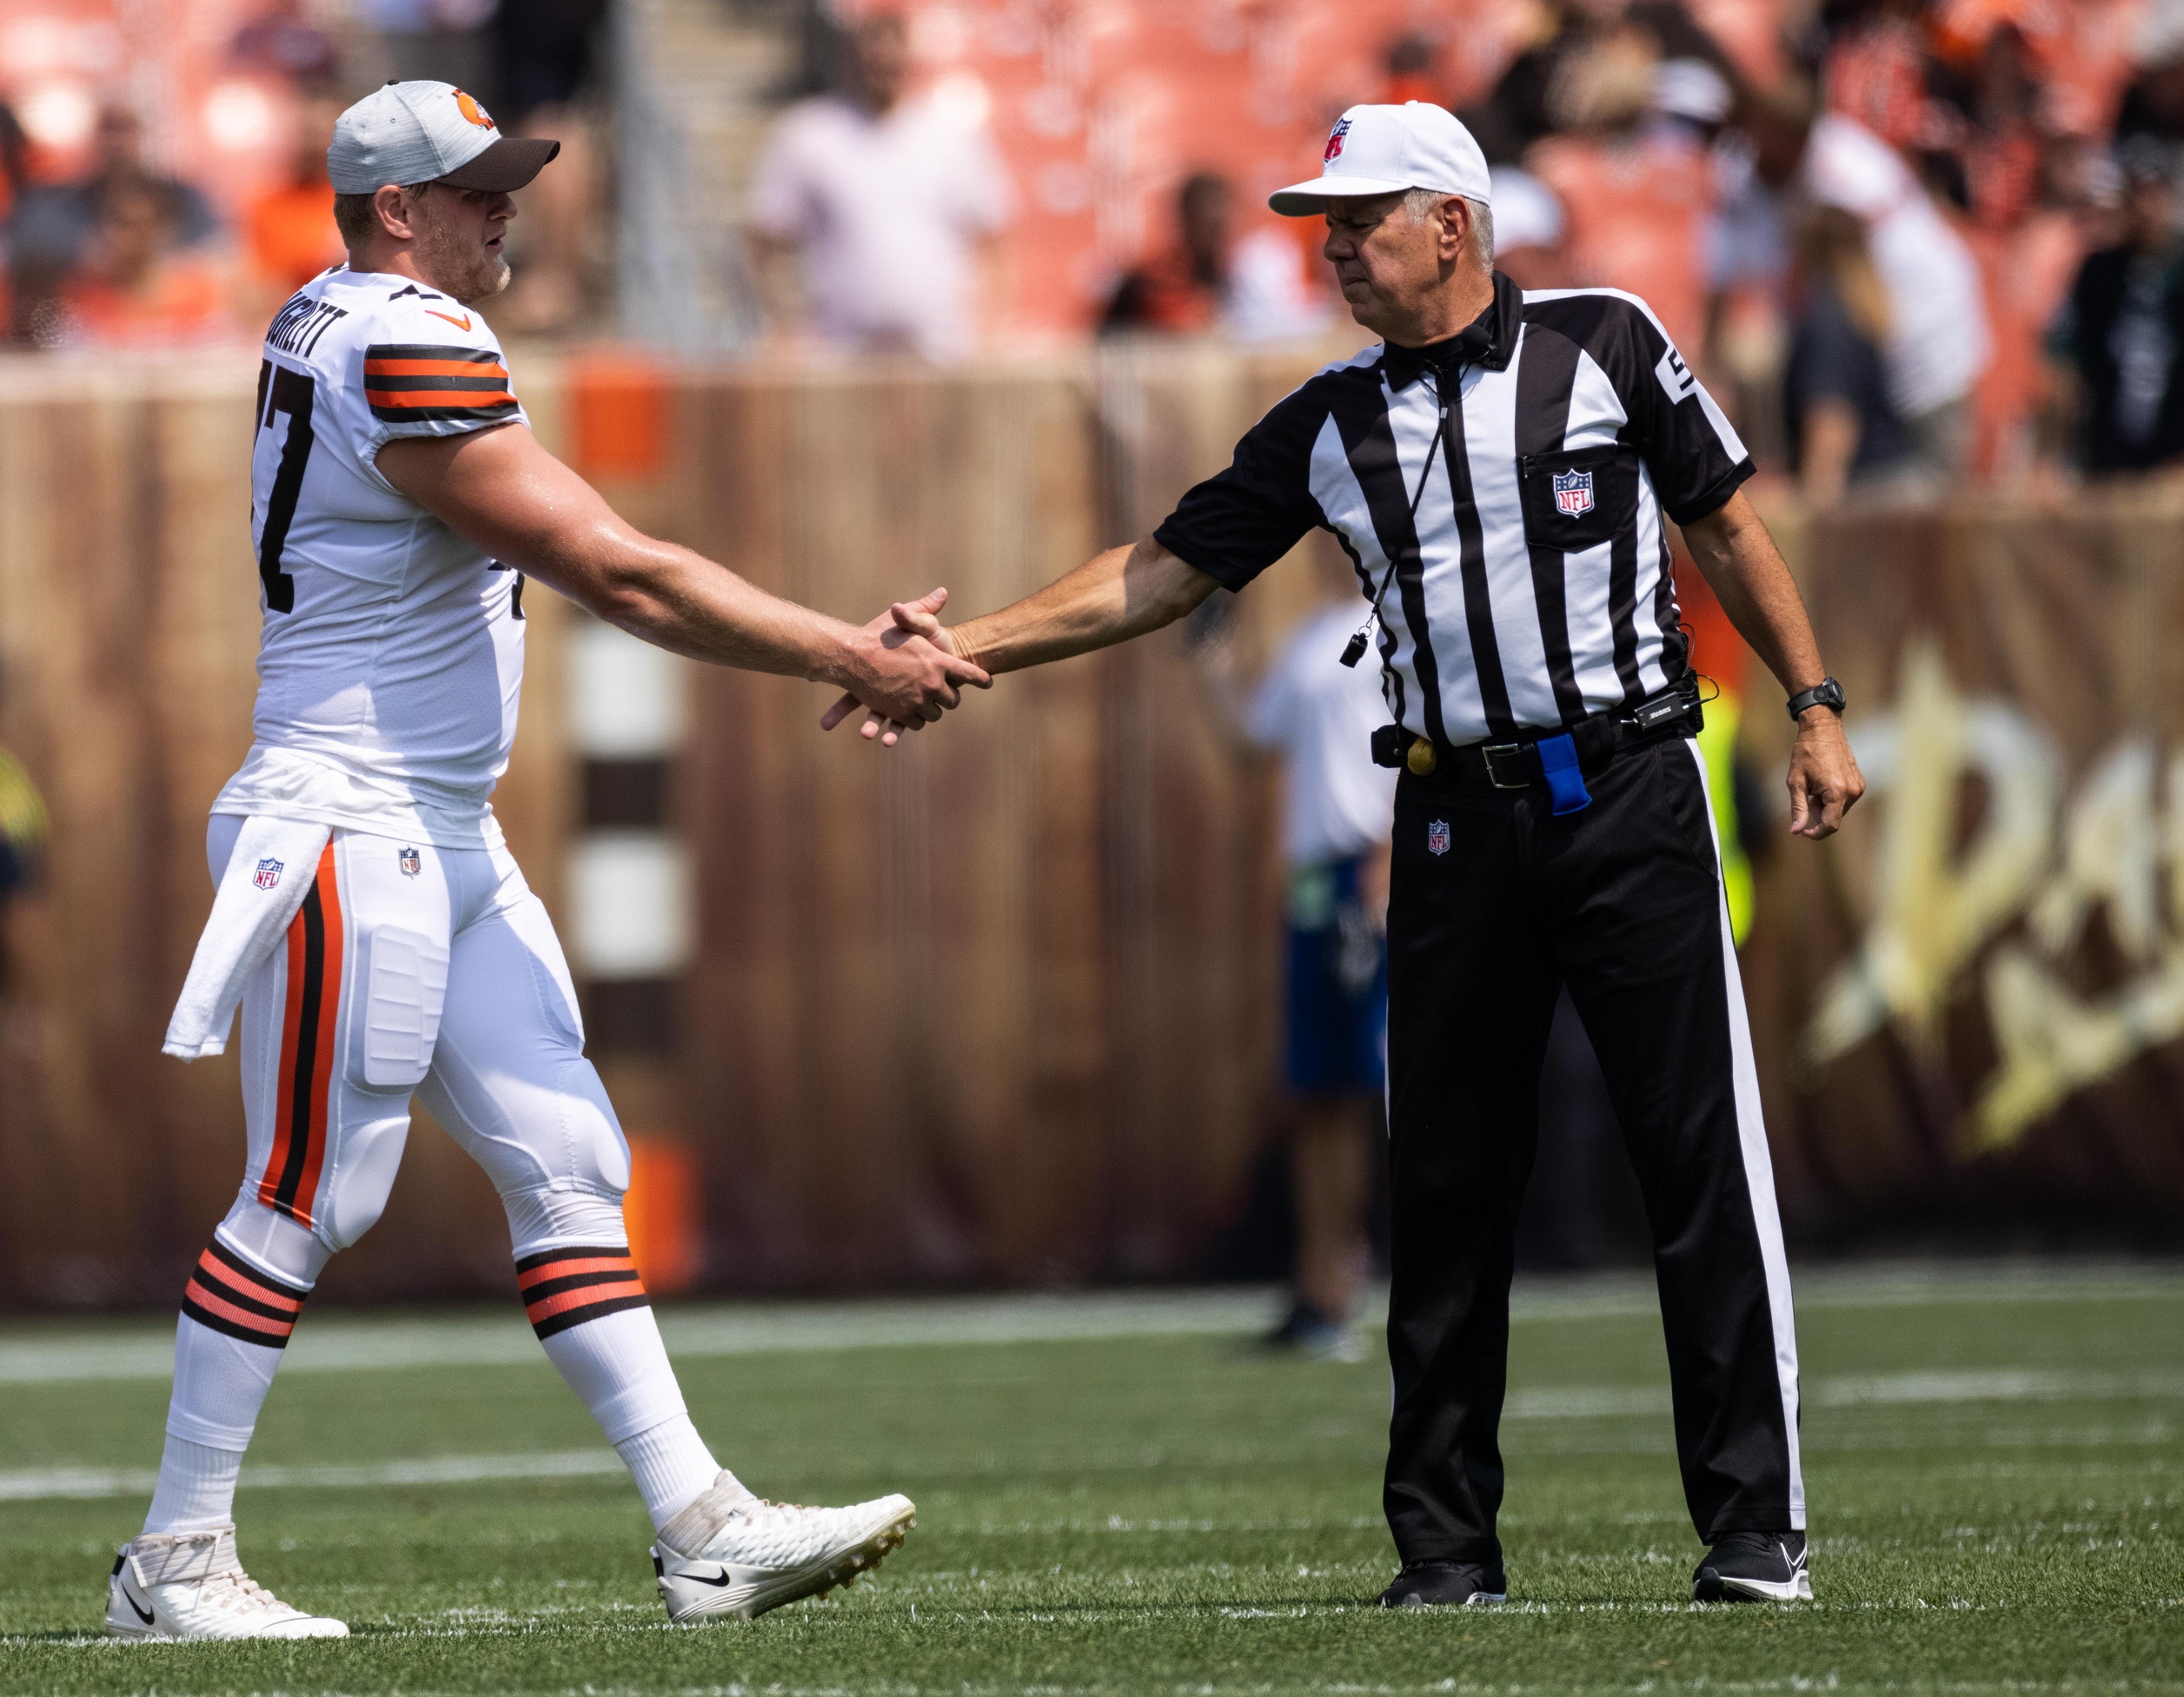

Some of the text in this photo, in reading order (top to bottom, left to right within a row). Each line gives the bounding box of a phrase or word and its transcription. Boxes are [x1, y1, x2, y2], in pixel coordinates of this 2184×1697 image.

[1559, 490, 1590, 511] NFL
[1650, 706, 1671, 719] SHURE
[1431, 834, 1447, 850] NFL
[403, 859, 418, 872] NFL
[256, 871, 276, 886] NFL
